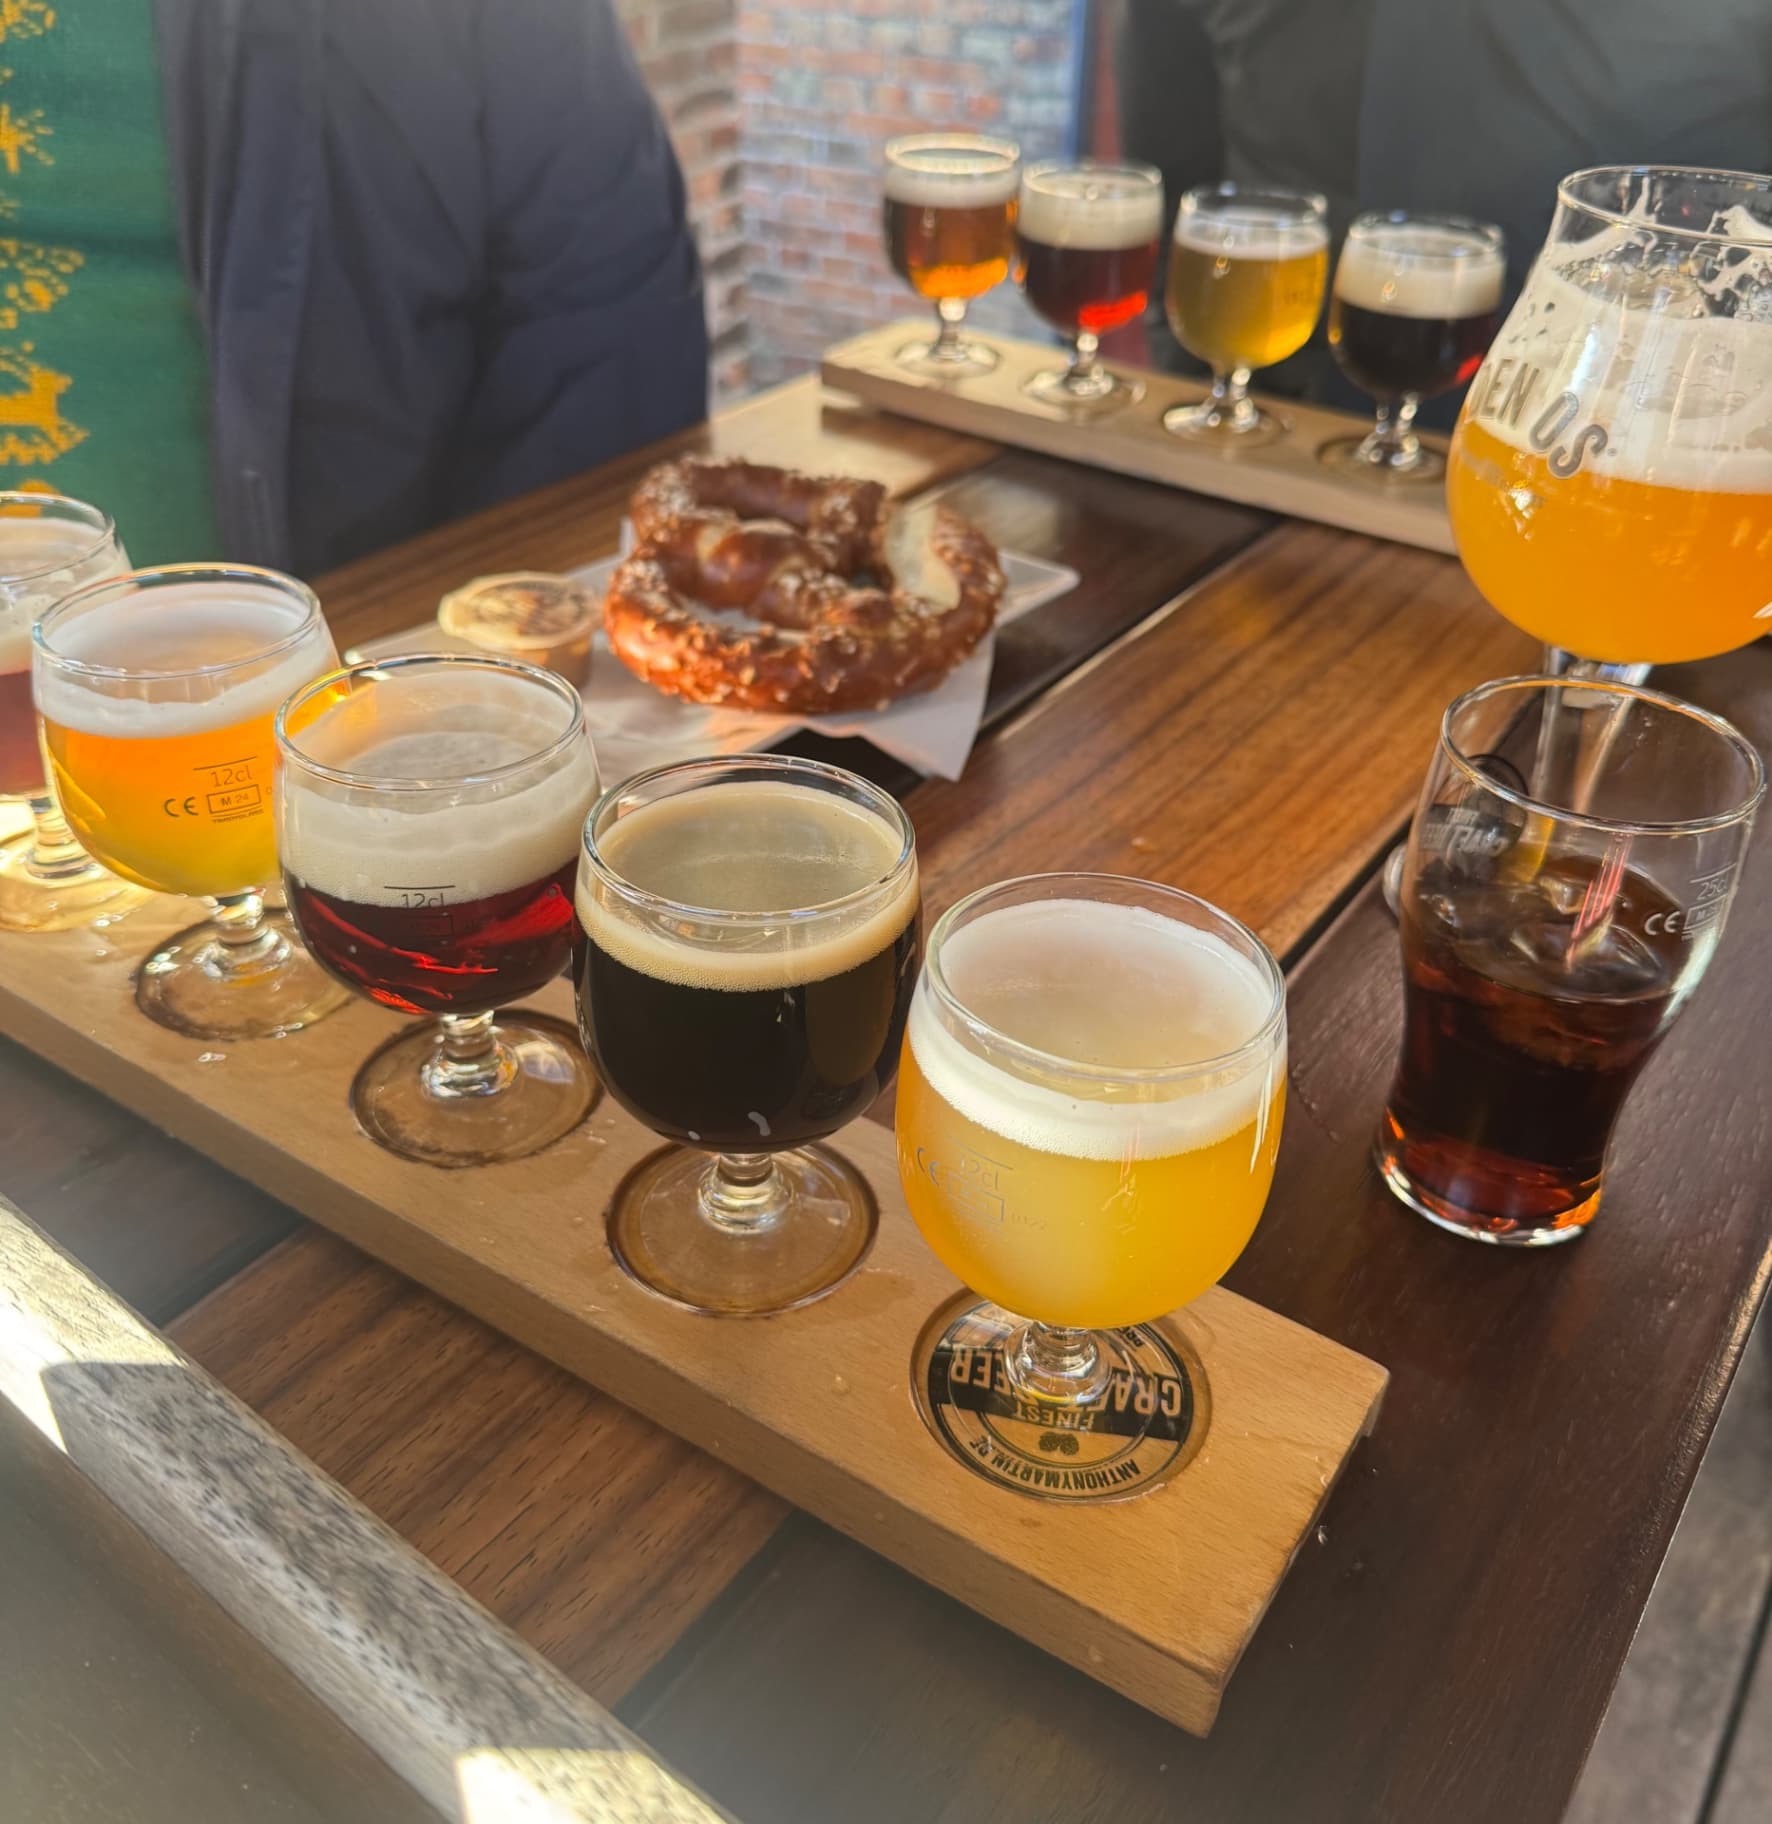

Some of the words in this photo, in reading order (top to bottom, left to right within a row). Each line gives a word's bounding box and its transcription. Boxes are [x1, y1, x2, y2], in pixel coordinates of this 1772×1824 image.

[210, 765, 253, 787] 12cl
[164, 797, 199, 818] CE
[401, 892, 445, 909] 12cl
[1644, 910, 1681, 936] CE
[1013, 1403, 1095, 1430] FINEST
